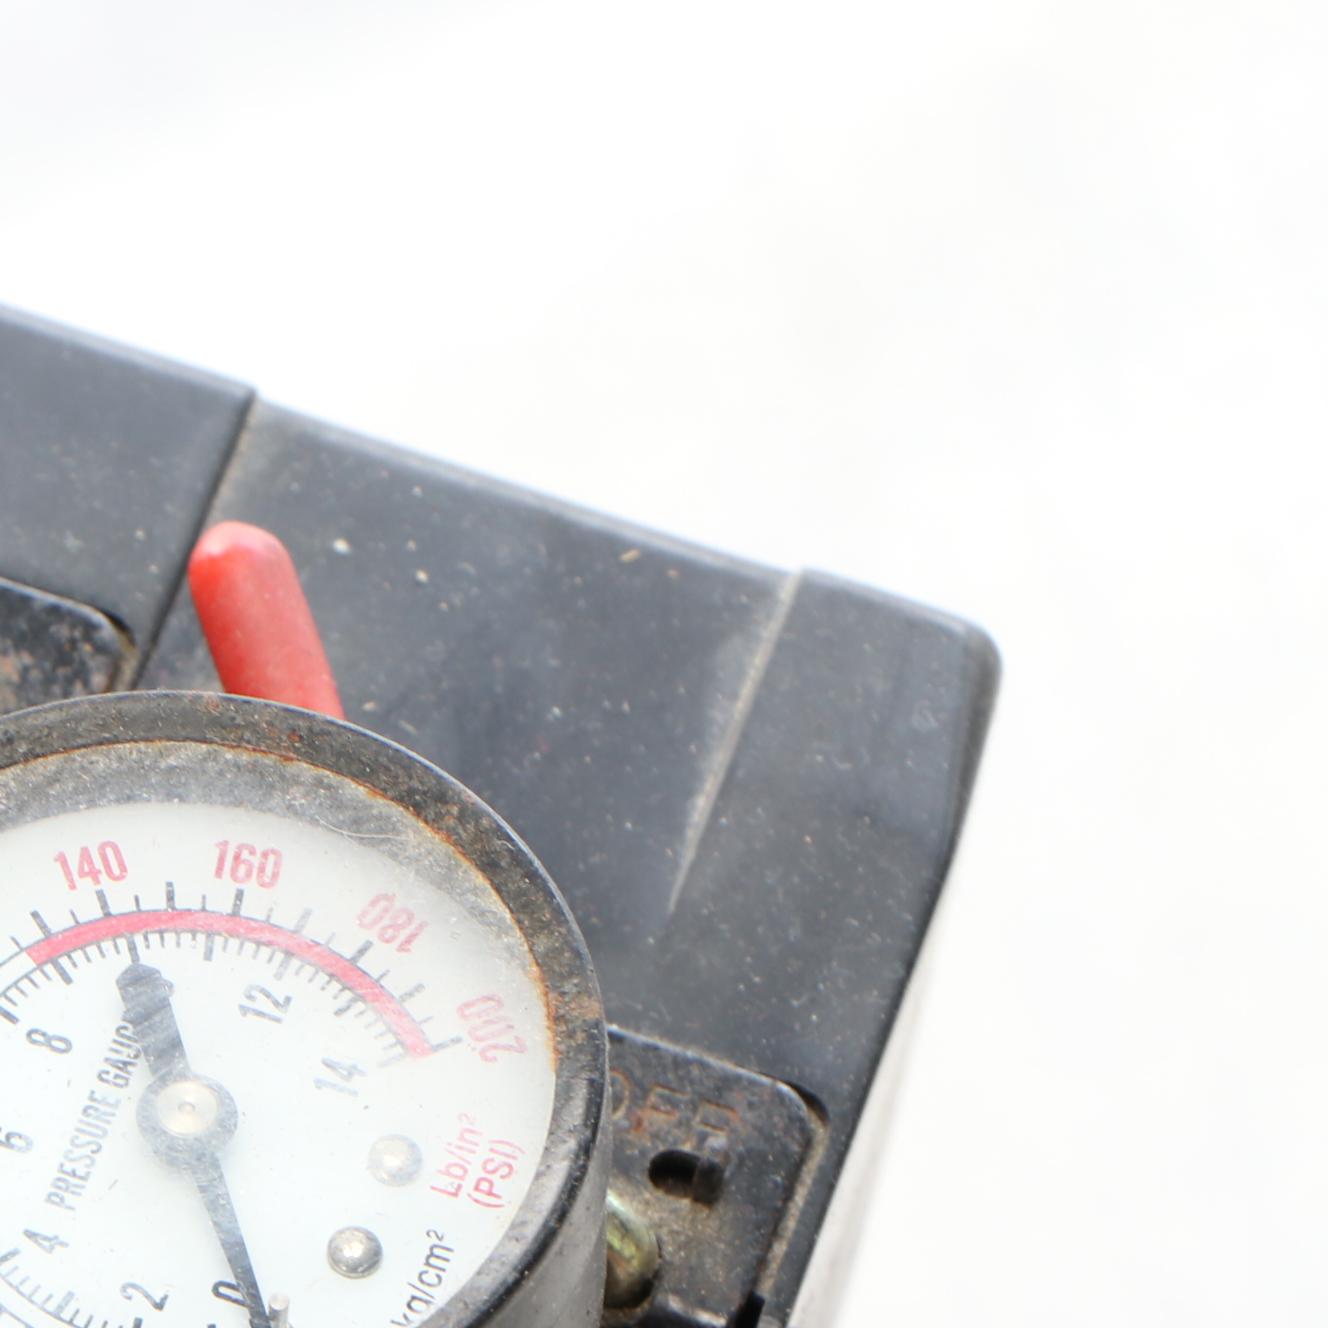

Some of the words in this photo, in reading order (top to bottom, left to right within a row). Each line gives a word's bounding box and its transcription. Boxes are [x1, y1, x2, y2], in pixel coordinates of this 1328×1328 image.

[53, 840, 128, 890] 140
[214, 839, 283, 889] 160
[356, 893, 429, 954] 180
[237, 984, 293, 1025] 12
[456, 993, 528, 1063] 200
[26, 1027, 72, 1054] 8
[313, 1055, 367, 1097] 14
[44, 1089, 122, 1211] PRESSURE
[96, 1021, 143, 1089] GAUG
[467, 1138, 526, 1209] (PSI)
[23, 1227, 69, 1253] 4
[120, 1281, 169, 1311] 2
